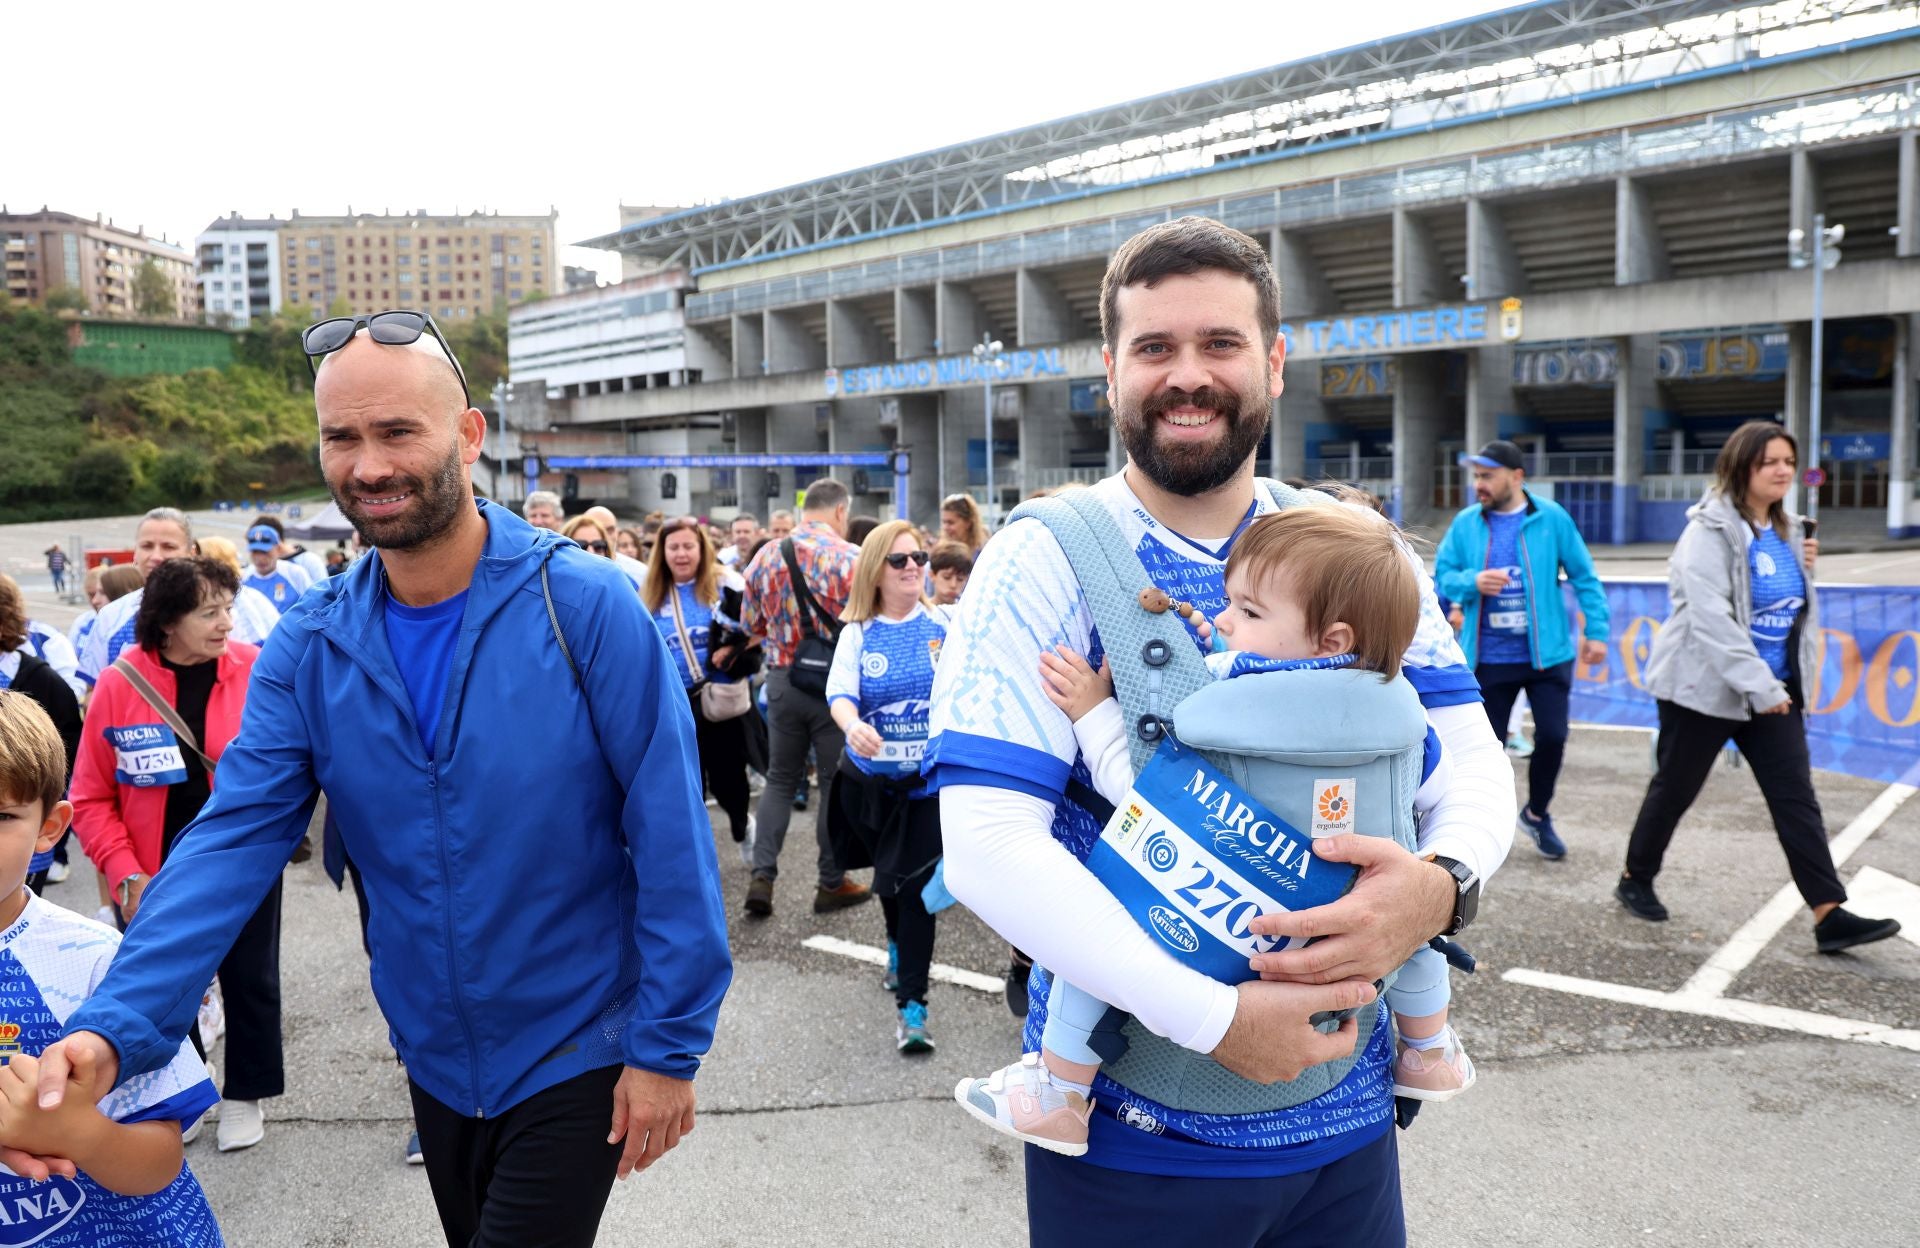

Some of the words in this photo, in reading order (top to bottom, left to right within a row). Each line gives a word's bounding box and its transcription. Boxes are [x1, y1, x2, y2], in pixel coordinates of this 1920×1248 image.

[1306, 304, 1487, 351] TARTIERE
[843, 360, 931, 394] ESTADIO
[1133, 508, 1158, 528] 1926
[113, 727, 162, 743] ARCHA
[1183, 768, 1313, 880] MARCHA
[1, 919, 30, 944] 2026
[1151, 908, 1194, 950] ASTURIANA
[0, 1187, 72, 1226] ANA
